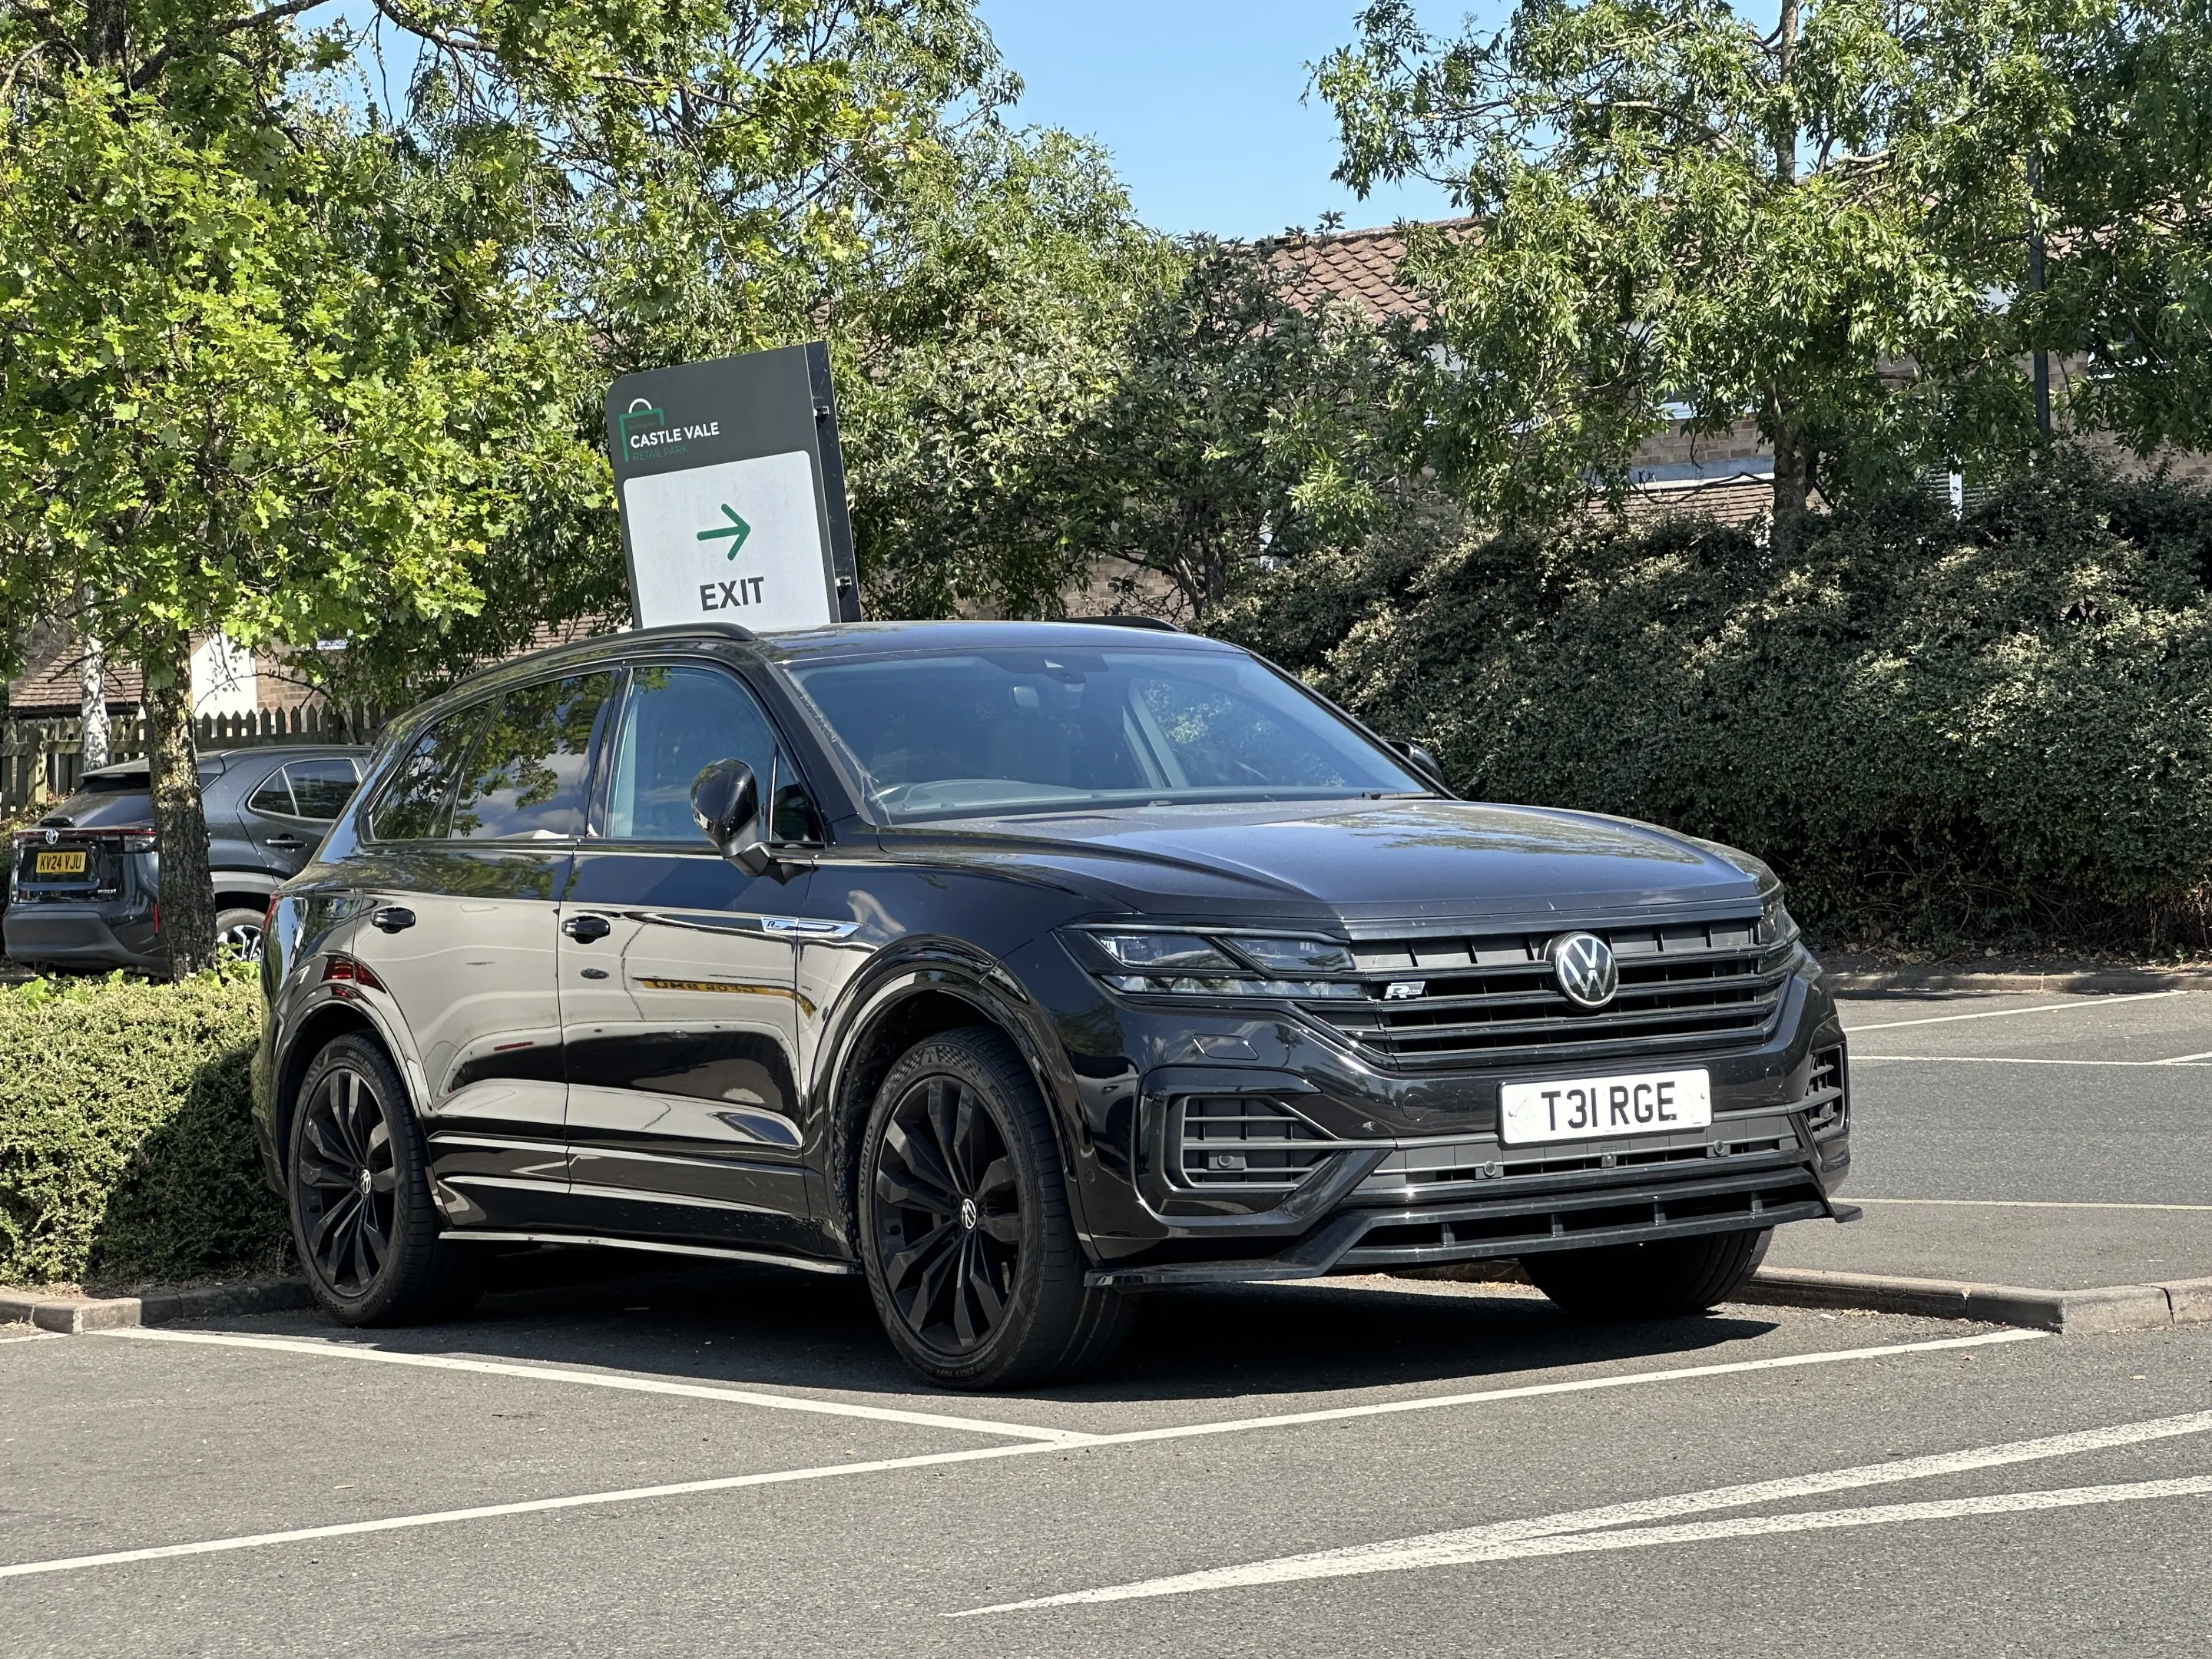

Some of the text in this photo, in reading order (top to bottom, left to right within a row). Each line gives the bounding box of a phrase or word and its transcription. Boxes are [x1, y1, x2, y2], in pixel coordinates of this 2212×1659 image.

[631, 422, 720, 449] CASTLE VALE
[632, 445, 689, 461] RETAIL PARK
[700, 576, 764, 611] EXIT
[40, 855, 82, 870] KV24 VJU
[1541, 1081, 1677, 1131] T31 RGE
[860, 1124, 873, 1199] KUMHO
[362, 1278, 389, 1313] KUMHO
